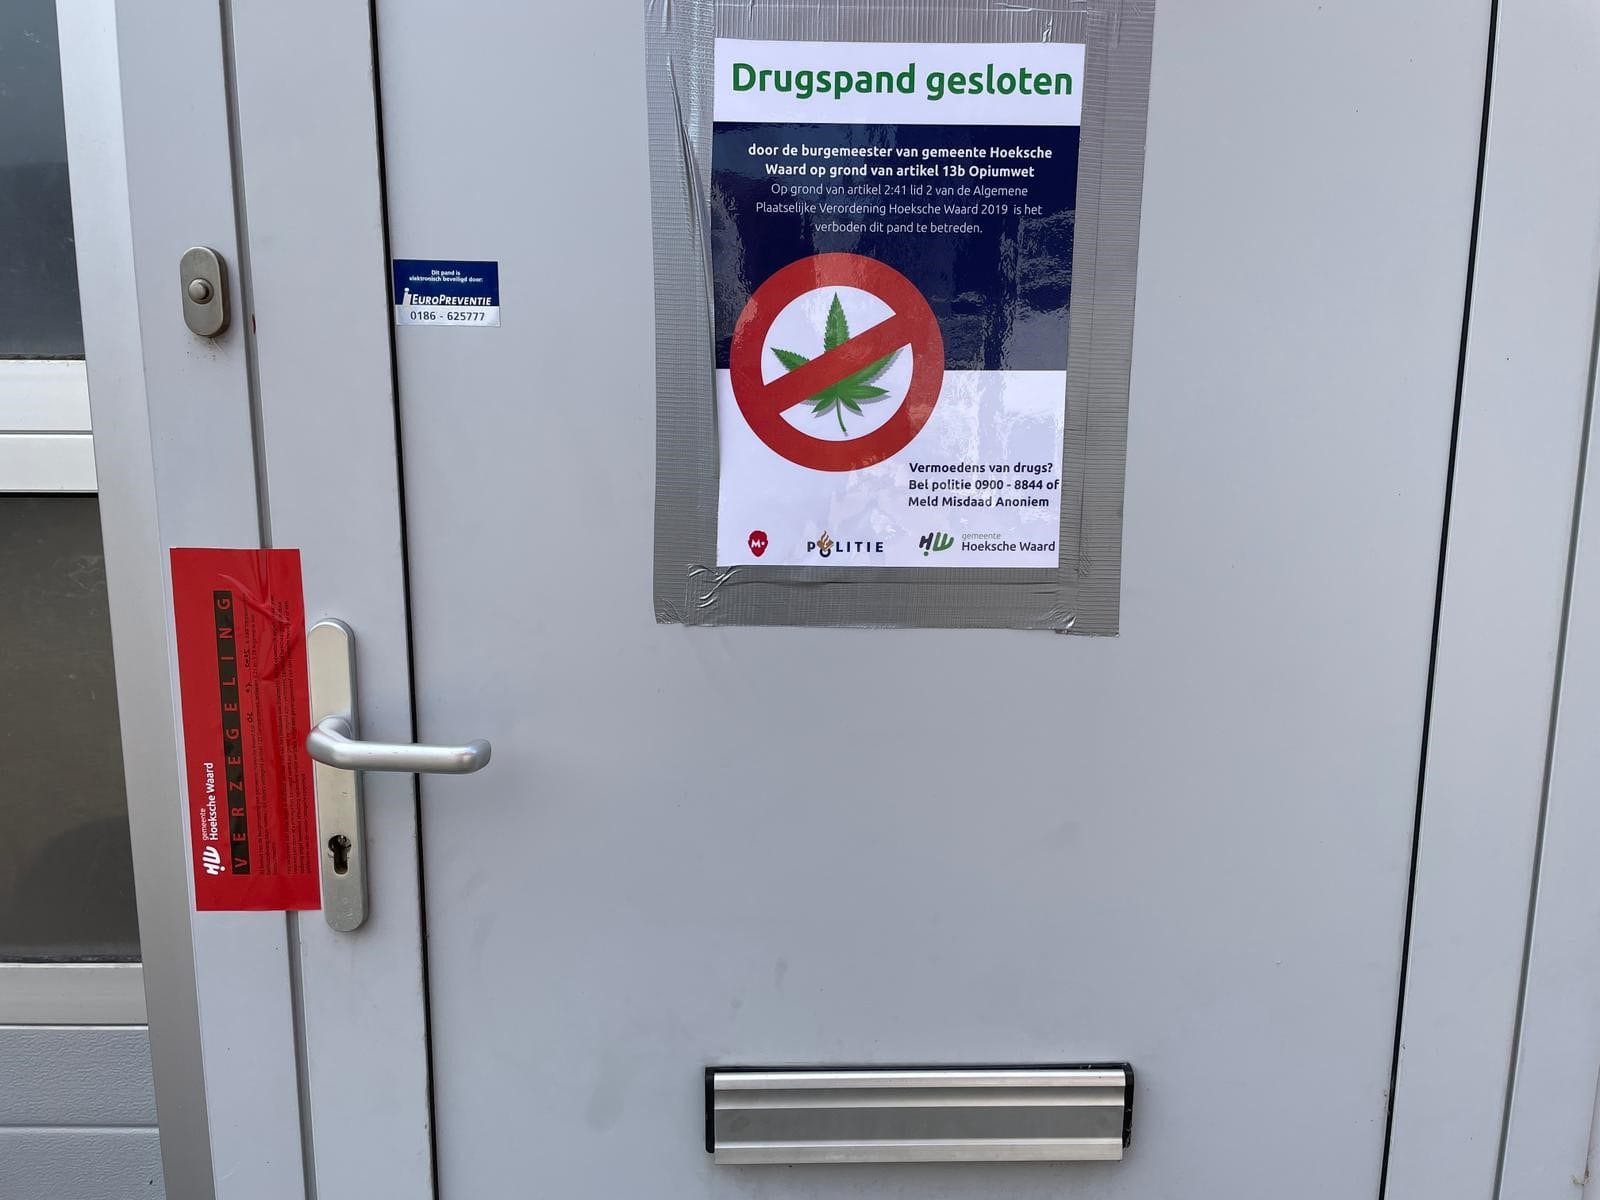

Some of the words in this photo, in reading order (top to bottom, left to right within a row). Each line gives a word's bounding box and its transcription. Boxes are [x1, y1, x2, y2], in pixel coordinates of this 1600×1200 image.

[732, 62, 916, 100] Drugspand
[926, 63, 1073, 101] gesloten
[748, 143, 779, 156] door
[782, 144, 798, 156] de
[802, 144, 892, 159] burgemeester
[896, 148, 918, 158] van
[922, 146, 987, 160] gemeente
[990, 146, 1053, 158] Hoeksche
[765, 163, 806, 175] Waard
[810, 166, 826, 177] op
[830, 164, 867, 178] grond
[871, 167, 893, 176] van
[896, 164, 939, 176] artikel
[942, 165, 965, 177] 13b
[969, 165, 1035, 179] Opiumwet
[771, 183, 787, 196] Op
[791, 184, 823, 196] grond
[826, 186, 845, 195] van
[847, 184, 881, 195] artikel
[884, 185, 906, 195] 2:41
[910, 184, 923, 195] lid
[926, 185, 933, 195] 2
[935, 187, 954, 195] van
[957, 185, 971, 196] de
[973, 185, 1028, 198] Algemene
[756, 202, 817, 215] Plaatselijke
[819, 203, 886, 216] Verordening
[889, 203, 941, 215] Hoeksche
[943, 204, 978, 215] Waard
[981, 204, 1008, 215] 2019
[1013, 204, 1022, 215] is
[1024, 204, 1043, 215] het
[815, 221, 867, 232] verboden
[870, 221, 884, 233] dit
[887, 222, 914, 234] pand
[916, 223, 928, 233] te
[931, 222, 983, 234] betreden.
[440, 269, 455, 277] pand
[410, 311, 436, 320] 0186
[447, 311, 485, 321] 625777
[909, 462, 986, 473] Vermoedens
[989, 464, 1010, 473] van
[1013, 462, 1053, 475] drugs?
[908, 479, 929, 490] Bel
[932, 479, 972, 491] politie
[975, 479, 1004, 490] 0900
[1014, 479, 1043, 490] 8844
[1046, 479, 1060, 490] of
[908, 495, 938, 507] Meld
[942, 495, 992, 507] Misdaad
[995, 496, 1049, 507] Anoniem
[961, 532, 1001, 542] gemeente
[807, 540, 884, 558] POLITIE
[961, 541, 1017, 552] Hoeksche
[1019, 541, 1056, 552] Waard
[217, 597, 248, 868] VERZEGELING
[204, 762, 216, 794] Waard
[202, 808, 210, 841] gemeente
[206, 795, 218, 841] Hoeksche
